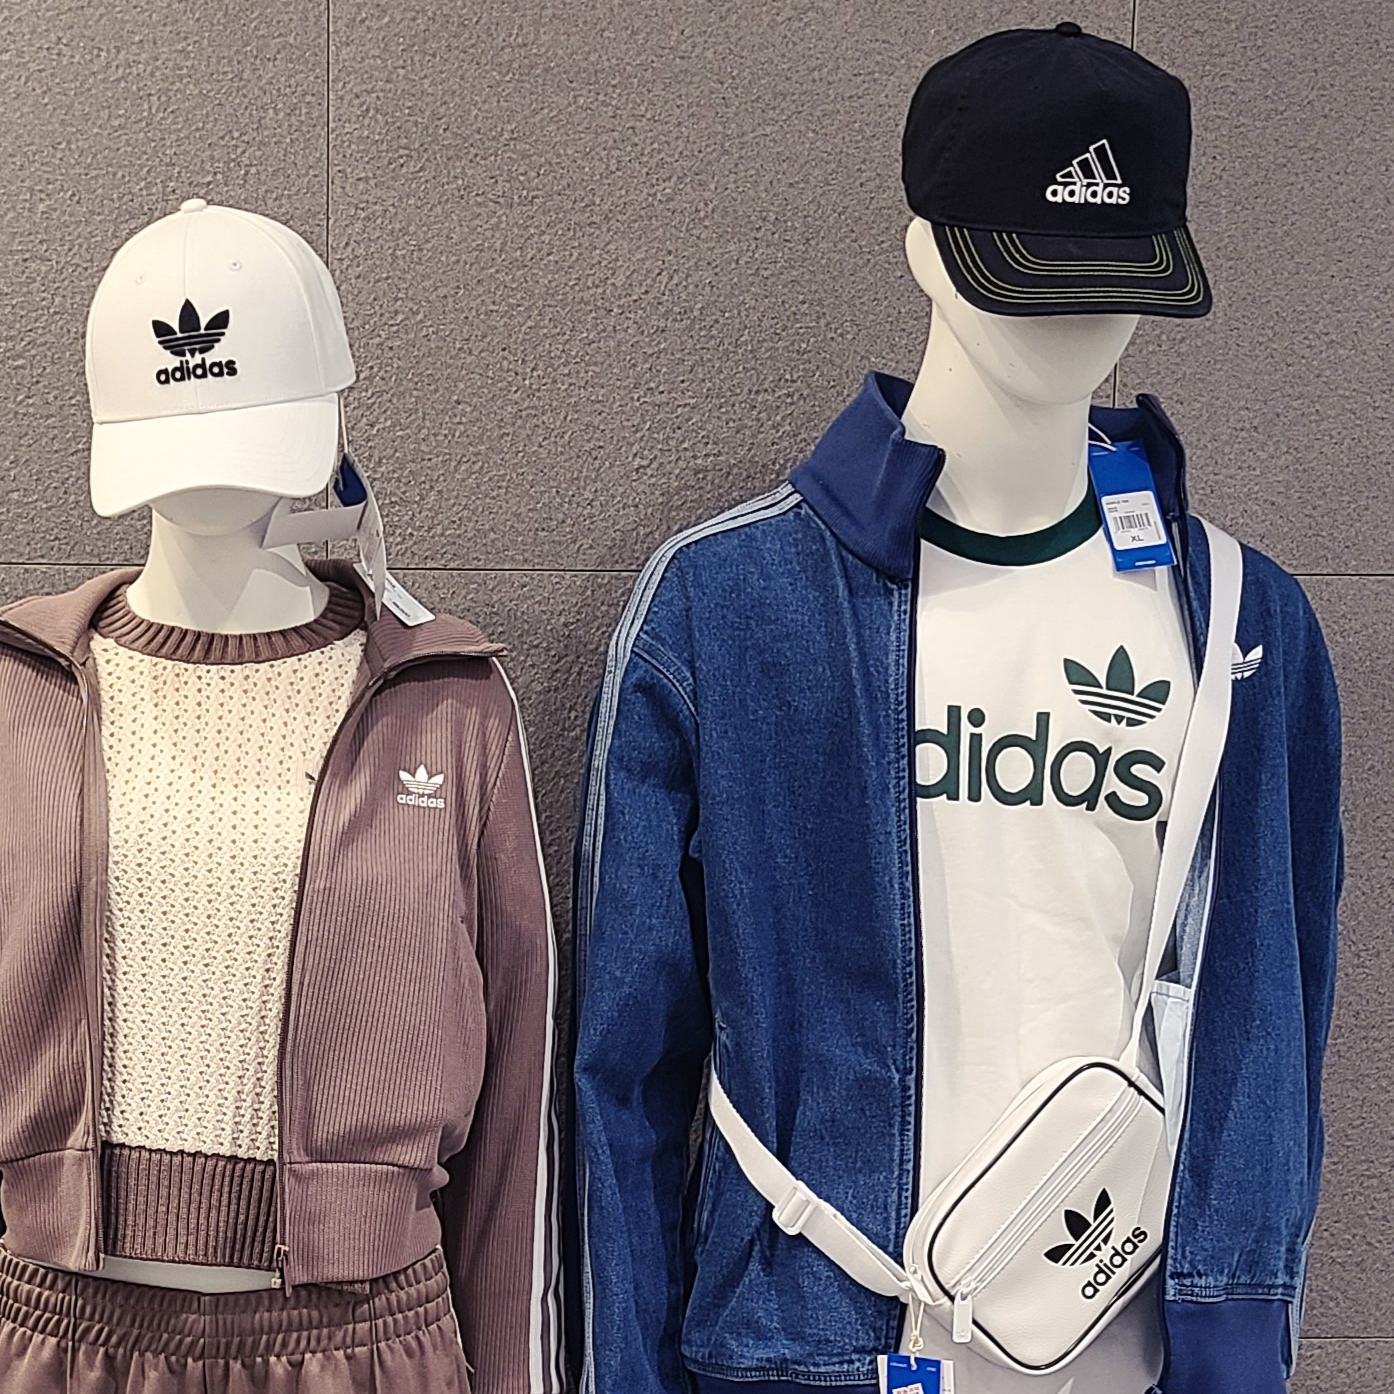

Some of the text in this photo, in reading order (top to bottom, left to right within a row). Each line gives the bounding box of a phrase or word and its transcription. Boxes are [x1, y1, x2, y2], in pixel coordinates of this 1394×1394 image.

[1045, 181, 1130, 205] adidas
[155, 356, 238, 385] adidas
[1130, 535, 1144, 543] XL
[914, 704, 1166, 822] didas
[396, 793, 445, 809] adidas
[1081, 1226, 1148, 1300] adidas
